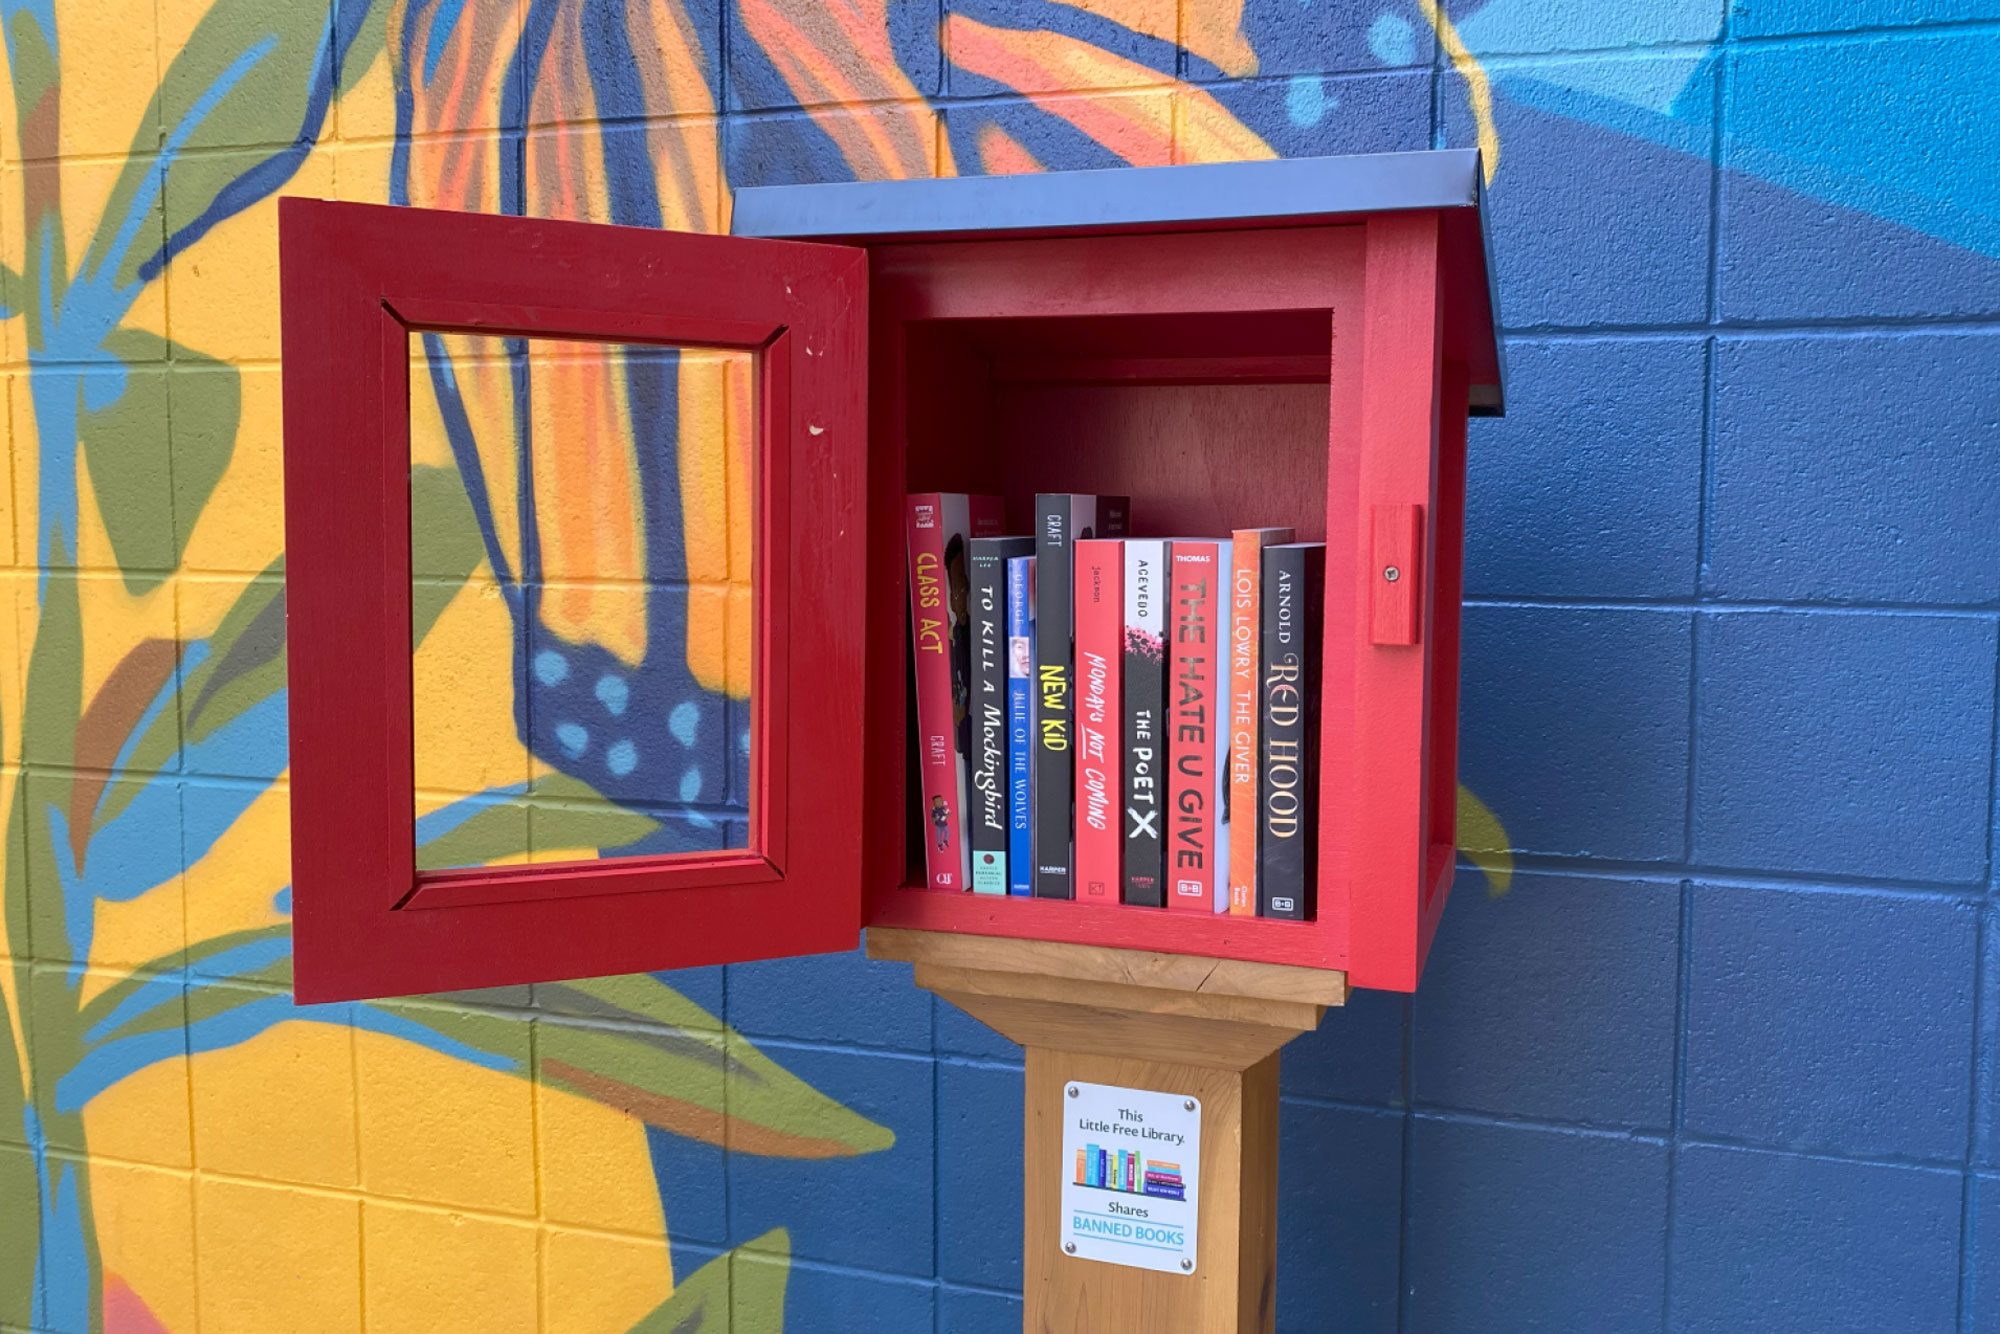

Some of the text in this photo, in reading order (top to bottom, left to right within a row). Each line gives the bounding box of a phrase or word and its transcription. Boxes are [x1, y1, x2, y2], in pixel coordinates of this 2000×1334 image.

[1047, 514, 1062, 547] CRAFT
[916, 552, 940, 608] CLASS
[1176, 555, 1211, 563] THOMAS
[1014, 574, 1025, 625] GEORGE
[1137, 560, 1149, 618] ACEVEDO
[1278, 570, 1291, 644] ARNOLD
[919, 617, 943, 654] ACT
[1039, 664, 1067, 710] NEW
[1084, 652, 1107, 723] MONDAY'S
[1234, 569, 1252, 784] LOIS LOWRY THE GIVER
[974, 585, 1003, 830] TO KILL A Mockingbird
[1136, 710, 1151, 740] THE
[1177, 577, 1207, 869] THE HATE U GIVE
[929, 735, 946, 766] CRAFT
[1013, 691, 1027, 830] JULIE OF THE WOLVES
[1265, 652, 1299, 839] RED HOOD
[1084, 767, 1110, 831] COMING
[1127, 806, 1159, 840] X
[1079, 1118, 1110, 1133] Little
[1112, 1123, 1139, 1138] Free
[1117, 1108, 1144, 1123] This
[1072, 1215, 1185, 1245] BANNED BOOKS
[1108, 1201, 1149, 1218] Shares
